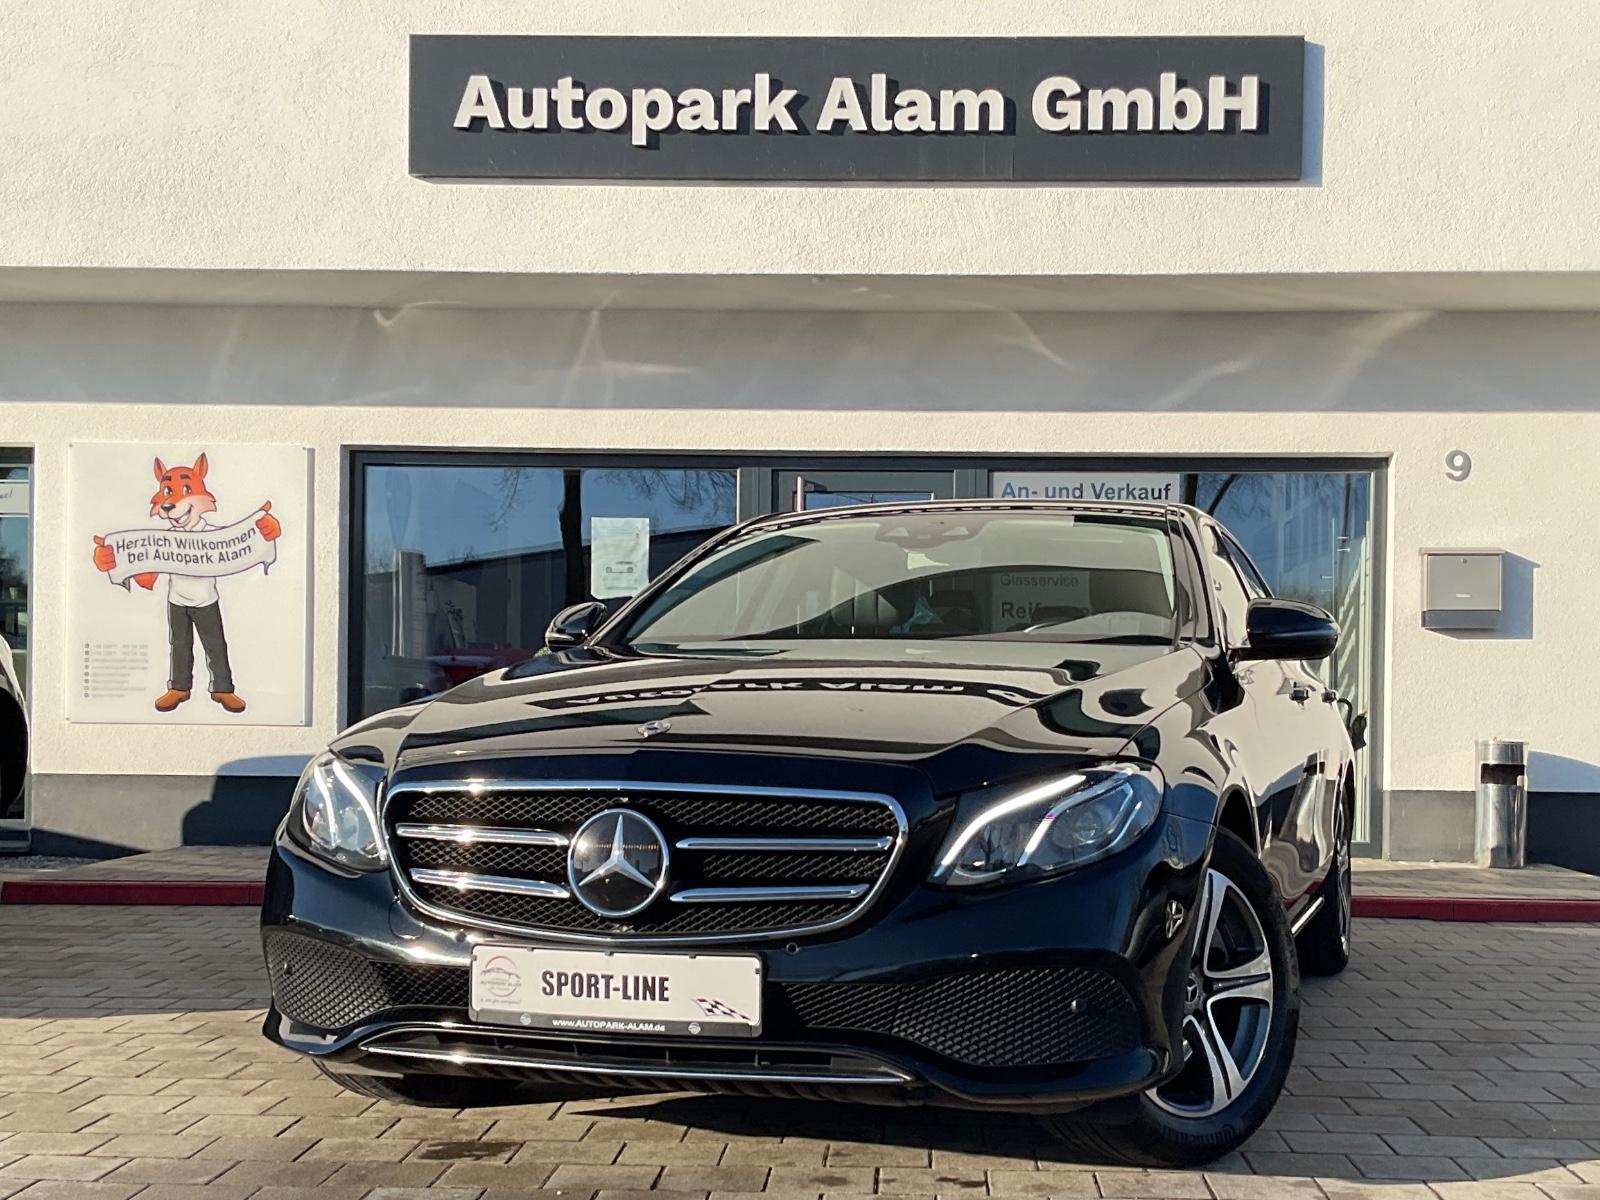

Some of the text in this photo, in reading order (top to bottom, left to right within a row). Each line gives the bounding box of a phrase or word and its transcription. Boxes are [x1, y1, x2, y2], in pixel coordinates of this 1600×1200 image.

[454, 72, 1259, 146] Autopark Alam GmbH
[1445, 450, 1472, 482] 9
[1001, 482, 1171, 500] An- und Verkauf
[116, 527, 256, 554] Herzlich Willkommen
[128, 544, 252, 565] bei Autopark Alam
[1000, 573, 1079, 587] Glasservice
[541, 970, 669, 1002] SPORT-LINE
